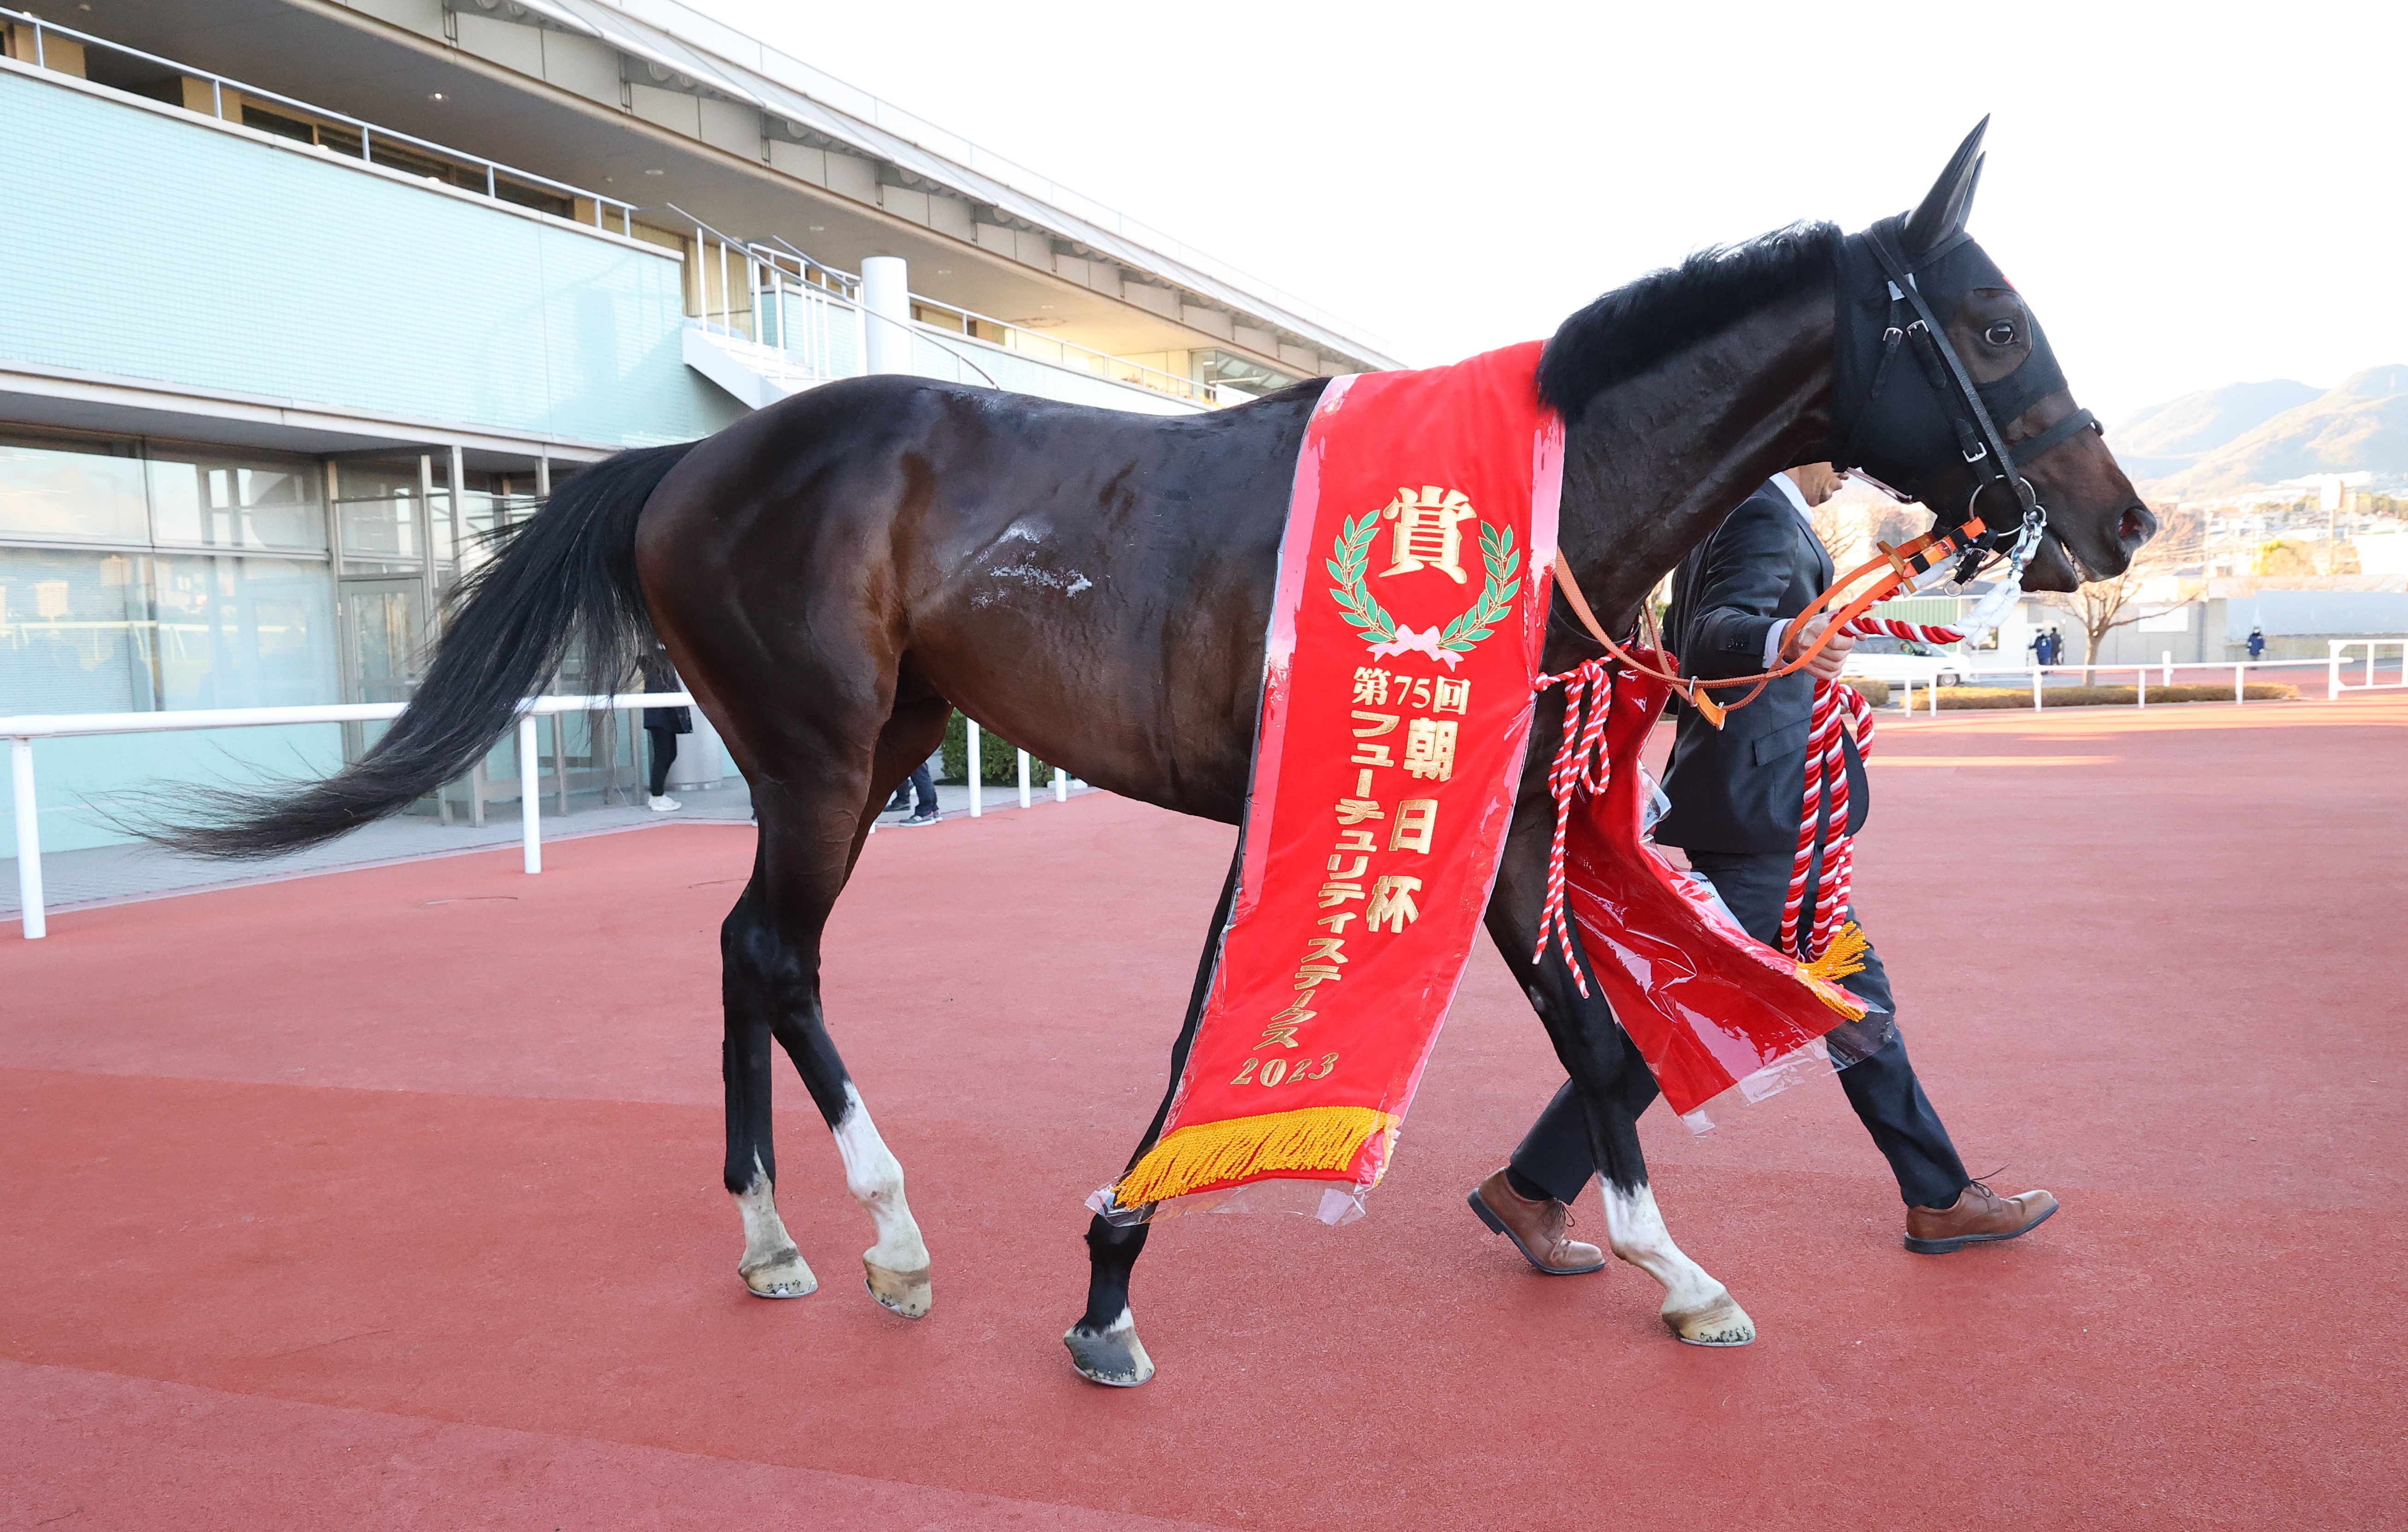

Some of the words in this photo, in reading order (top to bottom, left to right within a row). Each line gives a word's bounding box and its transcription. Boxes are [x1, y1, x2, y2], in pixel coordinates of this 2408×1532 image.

[1378, 485, 1477, 585] 賞
[1351, 667, 1471, 715] 第75回
[1365, 717, 1459, 934] 朝日杯
[1253, 709, 1401, 1051] フューチュリティステークス
[1230, 1053, 1339, 1088] 2023
